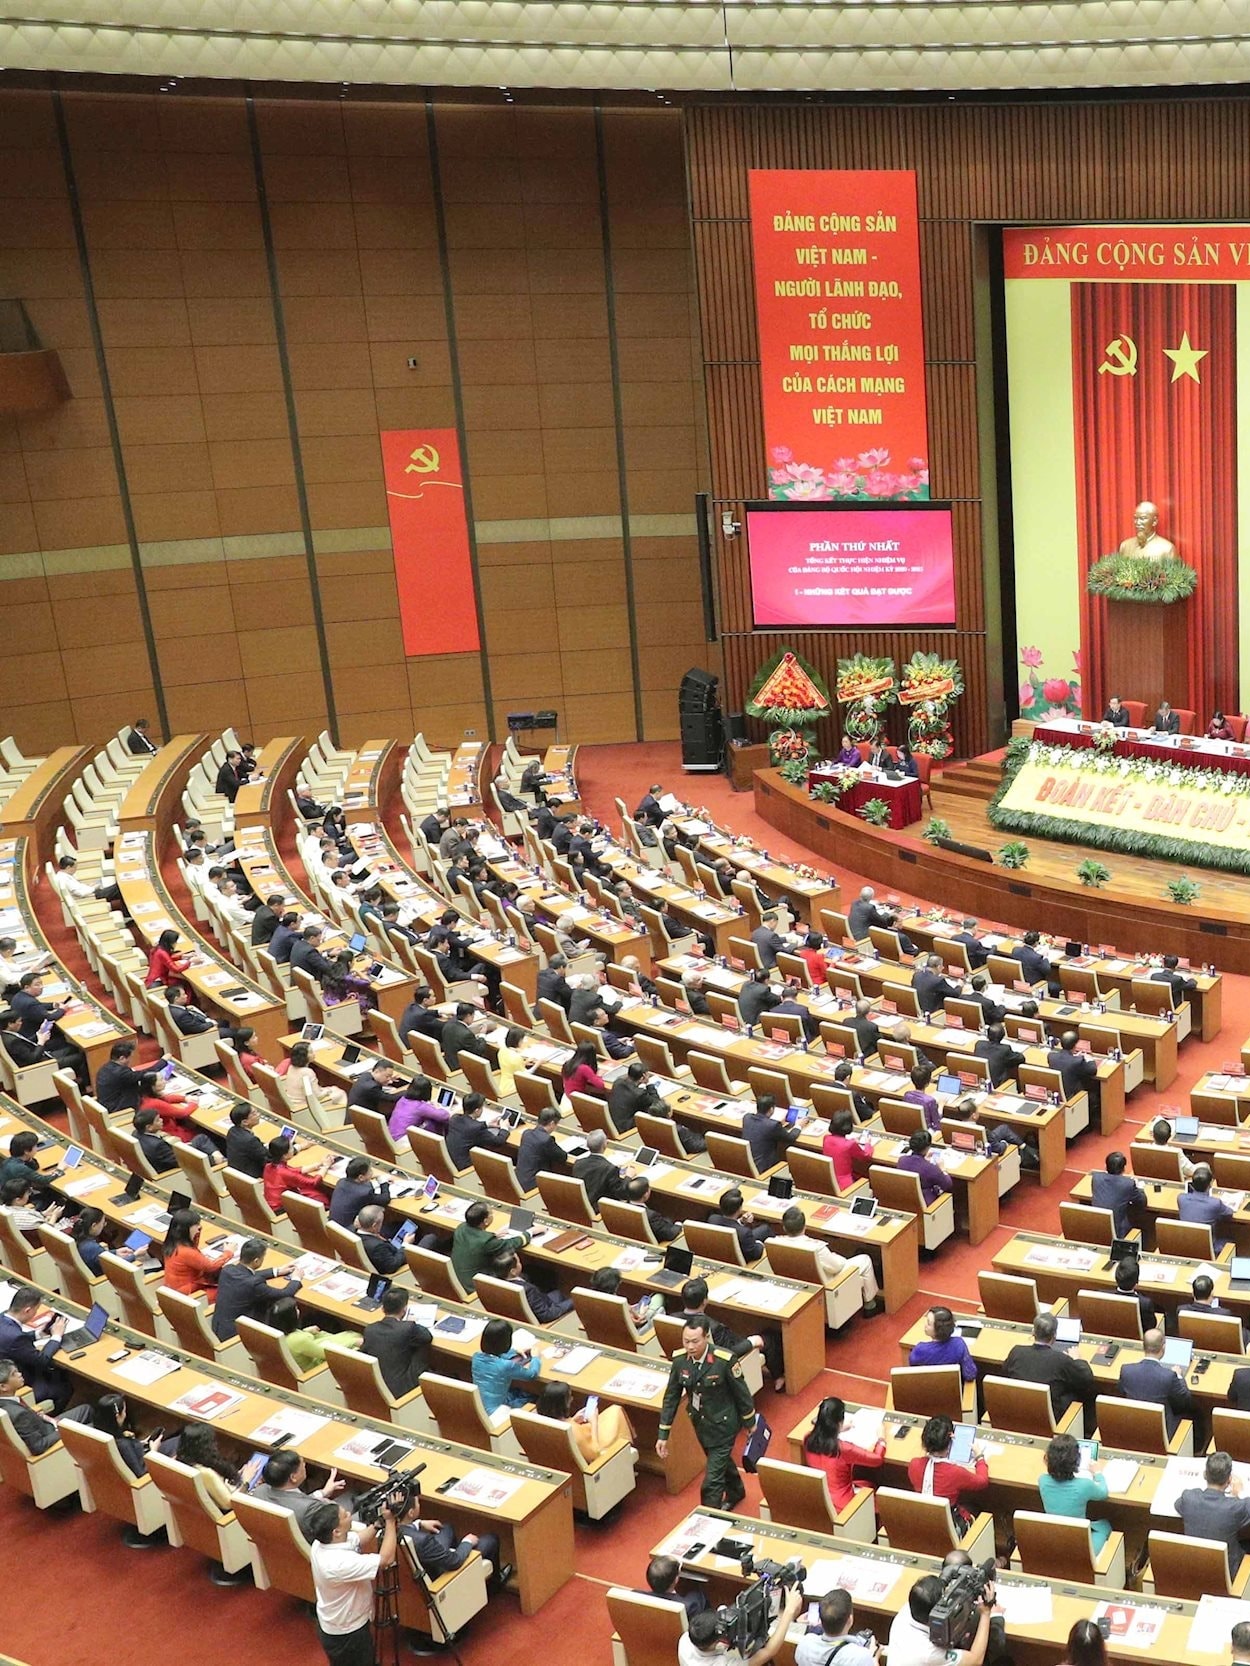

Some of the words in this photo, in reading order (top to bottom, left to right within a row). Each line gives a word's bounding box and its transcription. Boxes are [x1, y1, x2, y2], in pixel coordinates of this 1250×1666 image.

[773, 210, 816, 233] ĐẢNG
[819, 212, 861, 235] CỘNG
[865, 210, 897, 233] SẢN
[795, 245, 828, 268] VIỆT
[831, 248, 867, 265] NAM
[1023, 236, 1090, 266] ĐẢNG
[1095, 239, 1166, 272] CỘNG
[1172, 235, 1221, 267] SẢN
[774, 279, 821, 298] NGƯỜI
[825, 277, 865, 298] LÃNH
[868, 281, 903, 300] ĐẠO,
[808, 308, 828, 330] TỔ
[831, 310, 872, 330] CHỨC
[789, 345, 819, 364] MỌI
[822, 340, 872, 362] THẮNG
[875, 344, 899, 365] LỢI
[782, 372, 813, 393] CỦA
[816, 374, 857, 393] CÁCH
[860, 377, 905, 397] MẠNG
[812, 405, 844, 428] VIỆT
[847, 409, 883, 425] NAM
[809, 540, 840, 552] PHẦN
[841, 540, 867, 552] THỨ
[868, 539, 900, 552] NHẤT
[1035, 776, 1094, 809] ĐOÀN
[1089, 781, 1135, 816] KẾT
[1142, 793, 1192, 826] DÂN
[1189, 799, 1238, 833] CHỦ
